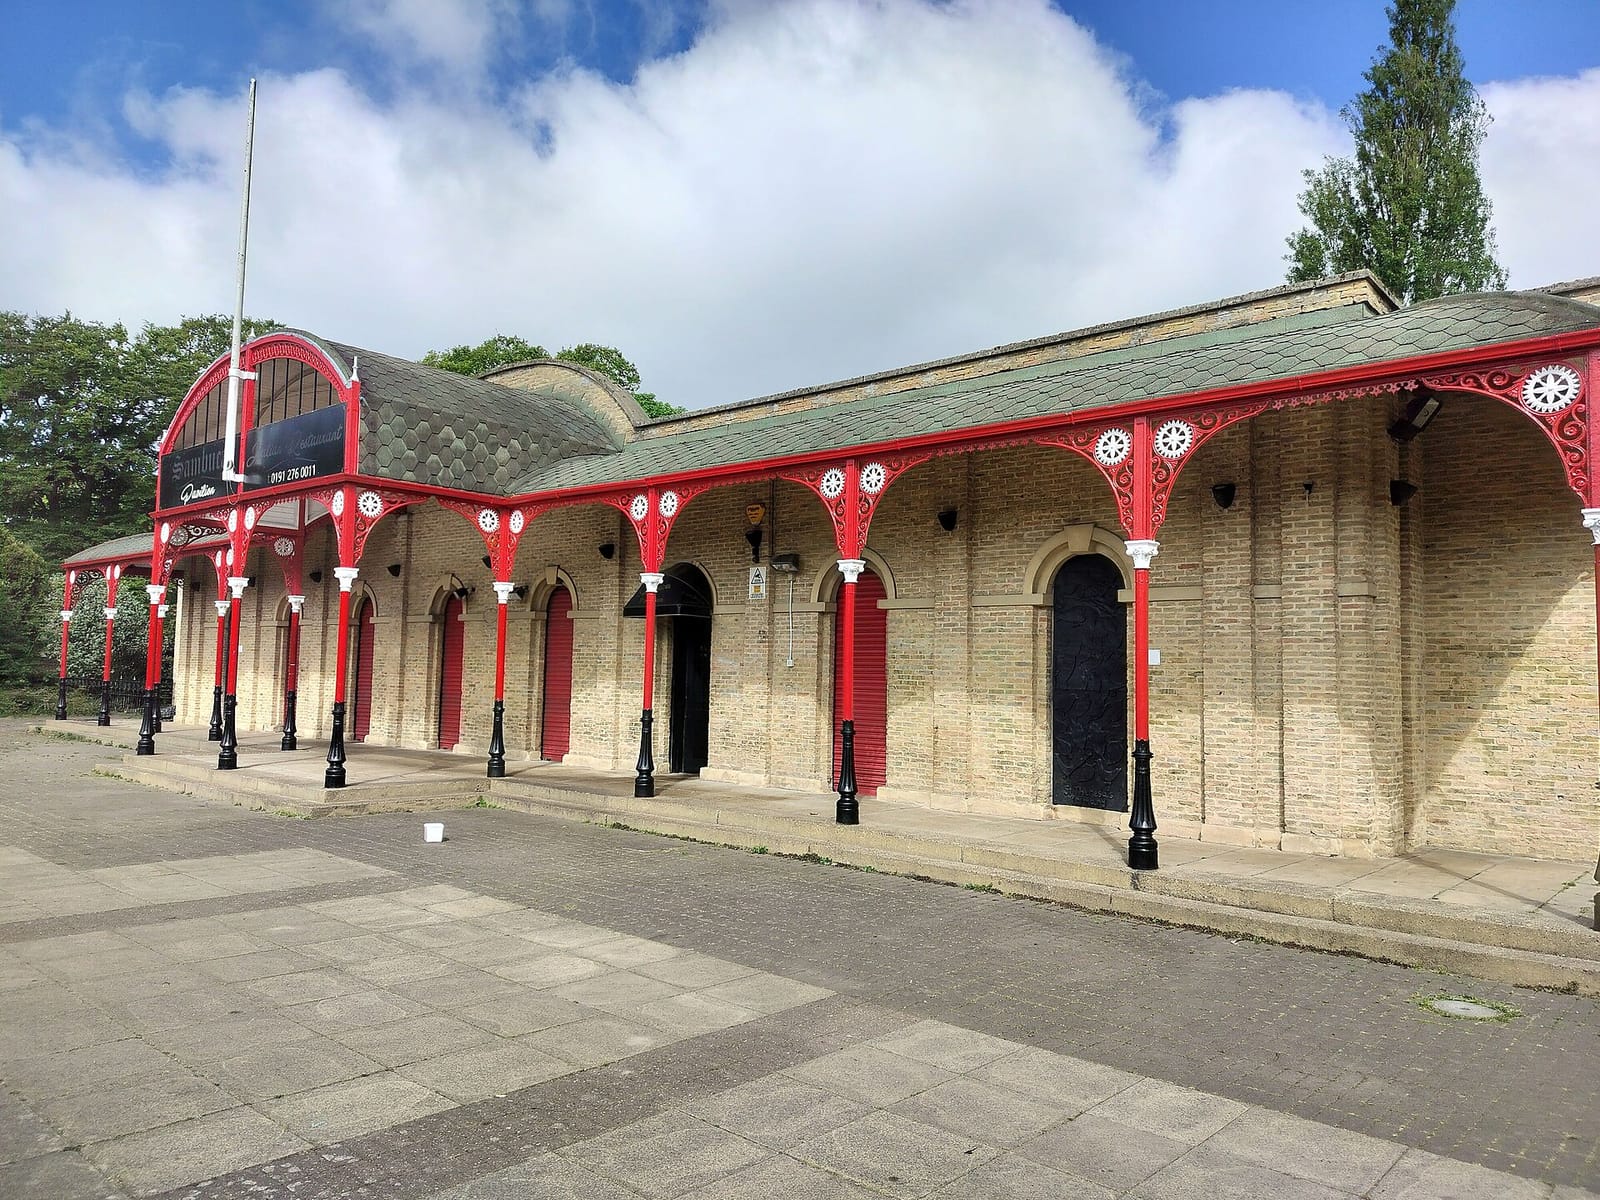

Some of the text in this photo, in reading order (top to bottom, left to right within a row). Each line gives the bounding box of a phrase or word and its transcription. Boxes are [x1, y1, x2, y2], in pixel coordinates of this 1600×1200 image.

[172, 447, 223, 481] Sambuc
[271, 470, 285, 484] 0191
[287, 467, 300, 481] 276
[300, 464, 316, 478] 0011
[180, 481, 217, 505] Pavilion
